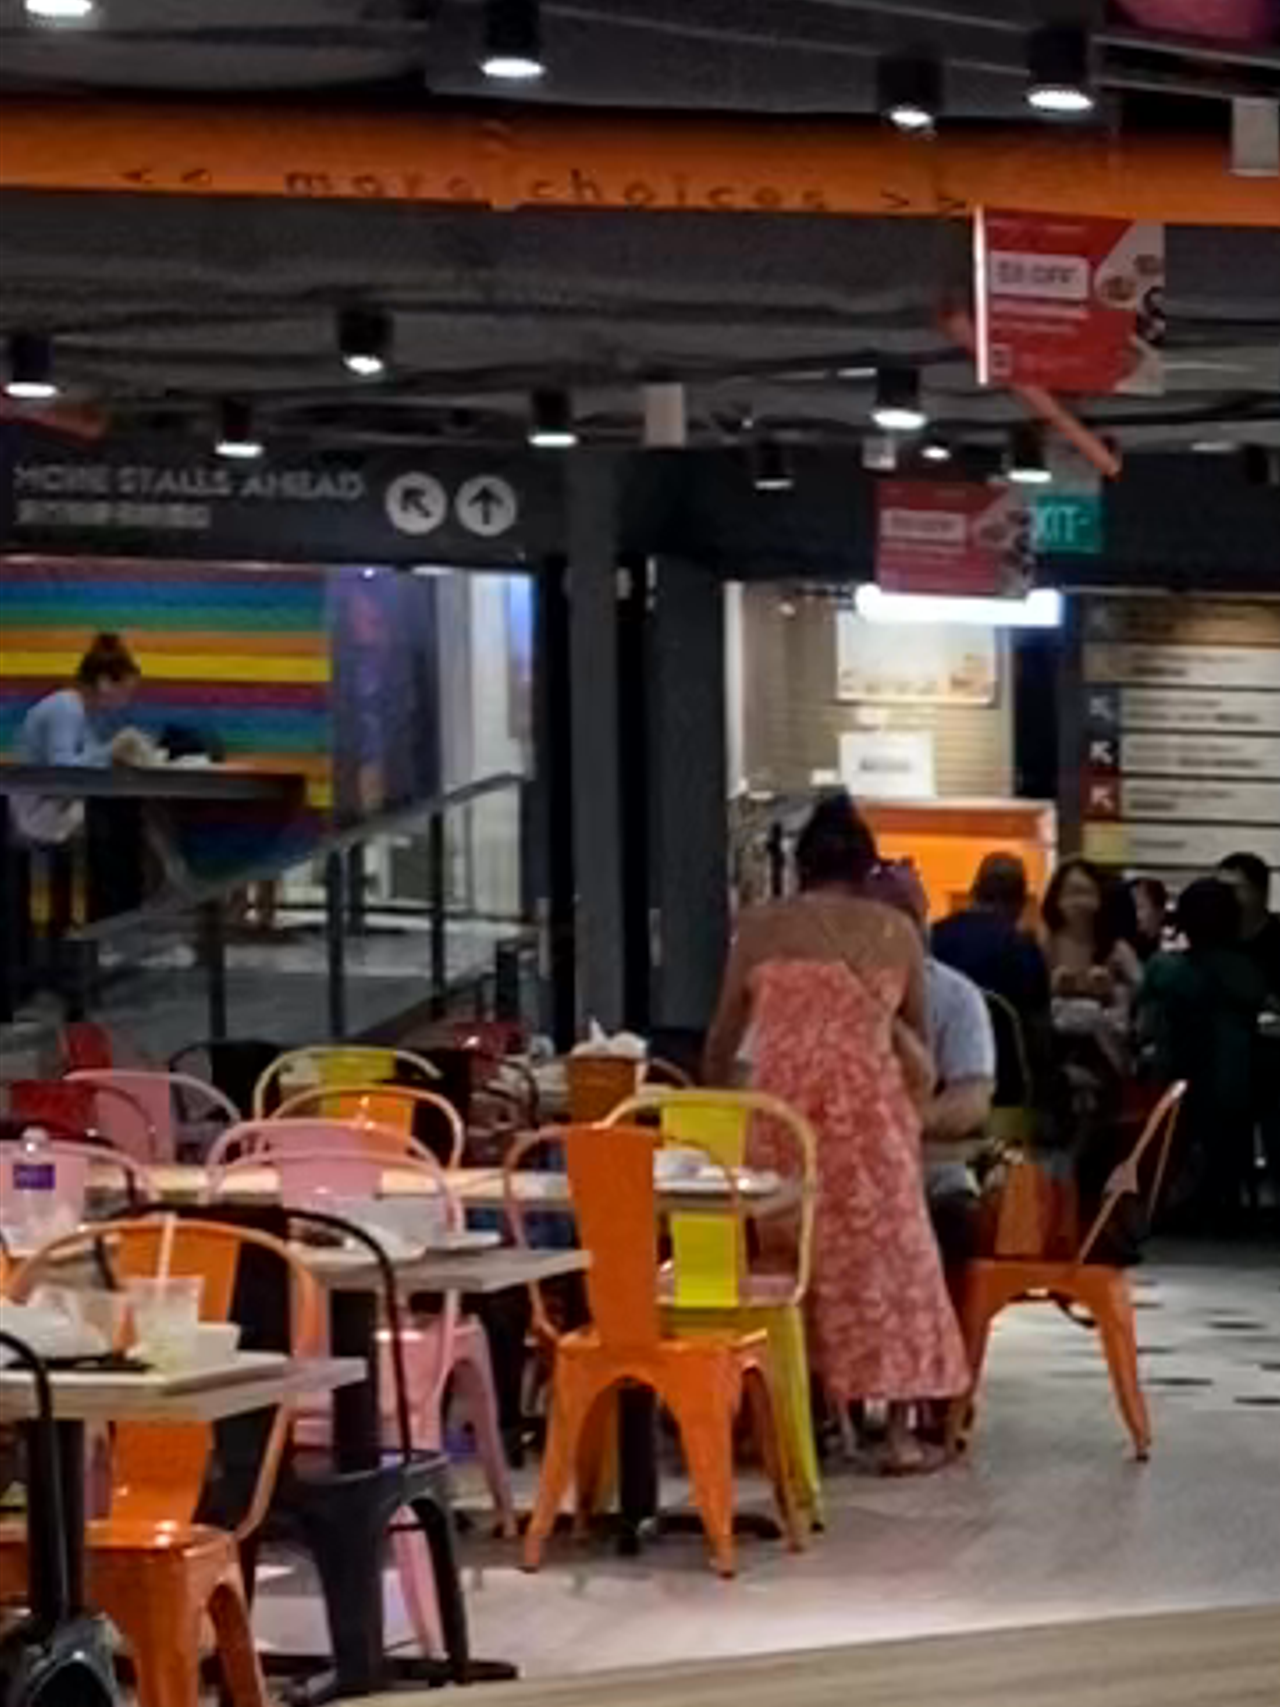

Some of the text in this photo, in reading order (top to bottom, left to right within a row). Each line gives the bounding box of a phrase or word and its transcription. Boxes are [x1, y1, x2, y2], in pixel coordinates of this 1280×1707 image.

[13, 465, 364, 500] MORE STALLS AHEAD
